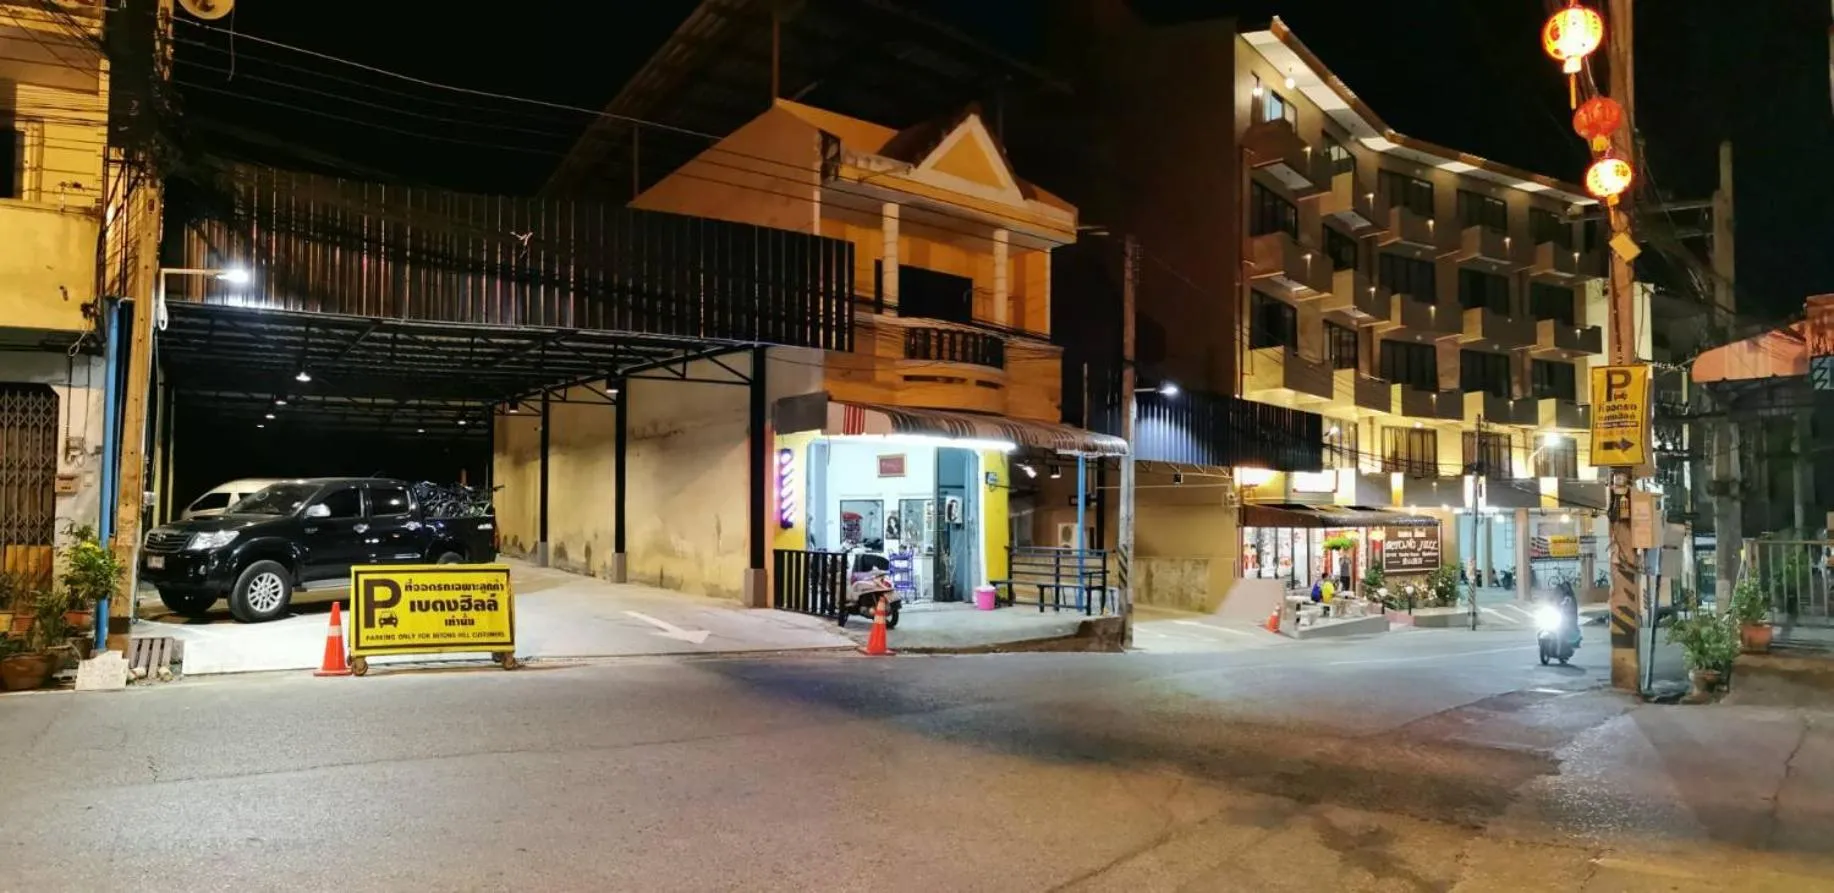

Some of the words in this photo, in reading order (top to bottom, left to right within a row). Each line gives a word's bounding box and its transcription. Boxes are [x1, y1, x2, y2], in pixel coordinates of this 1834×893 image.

[1606, 369, 1632, 401] P
[363, 578, 402, 629] P
[409, 593, 498, 613] เบตงฮิลล์
[366, 634, 396, 642] PARKING
[398, 633, 416, 641] ONLY
[417, 632, 431, 640] FOR
[472, 631, 505, 639] CUSTOMERS
